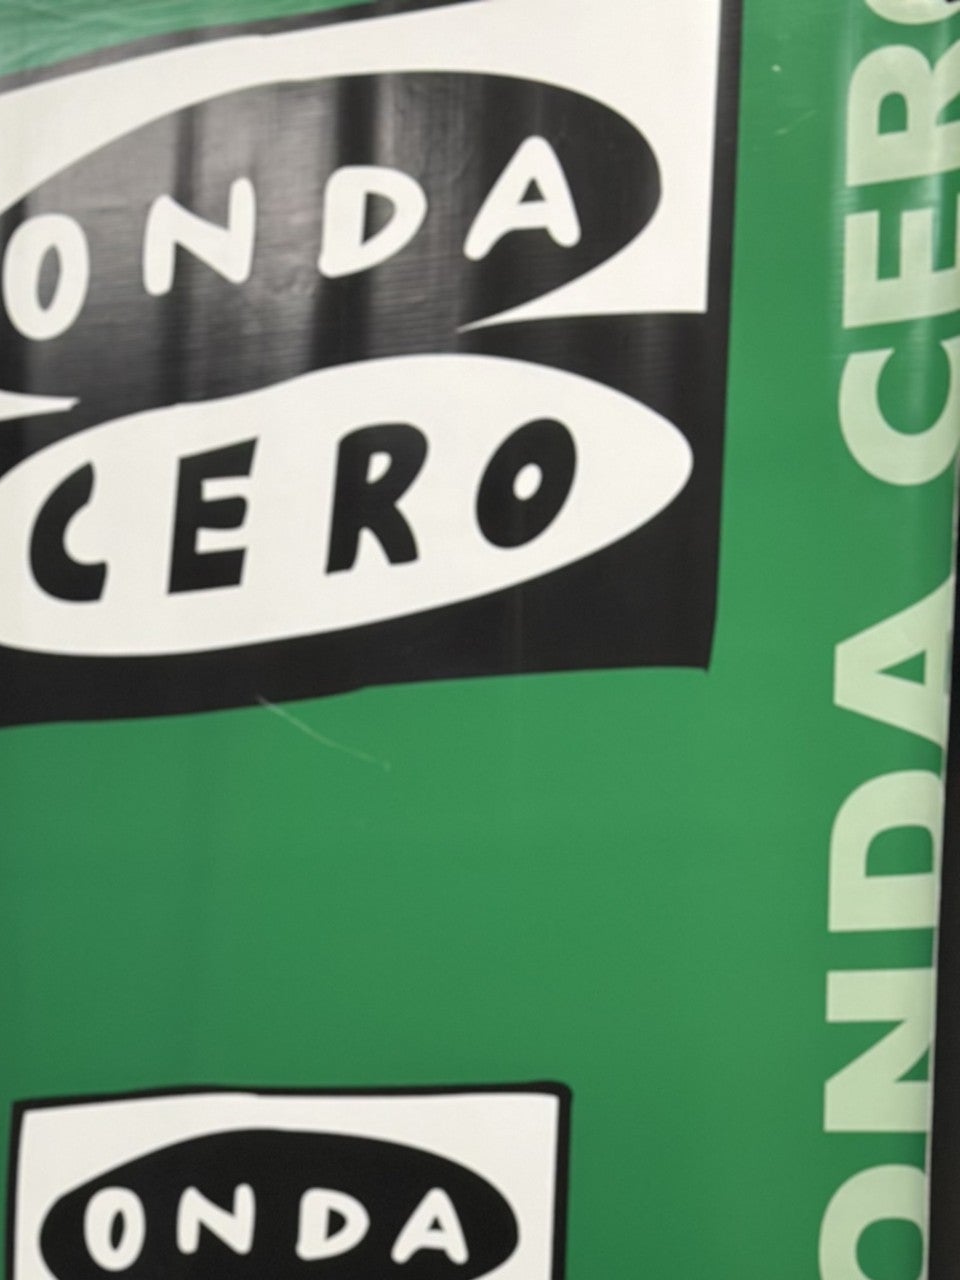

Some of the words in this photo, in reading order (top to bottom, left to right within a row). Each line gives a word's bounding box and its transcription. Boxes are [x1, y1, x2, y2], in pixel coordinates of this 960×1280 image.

[2, 135, 581, 341] ONDA
[838, 0, 960, 486] CER
[28, 417, 578, 603] CERO
[84, 1183, 468, 1272] ONDA
